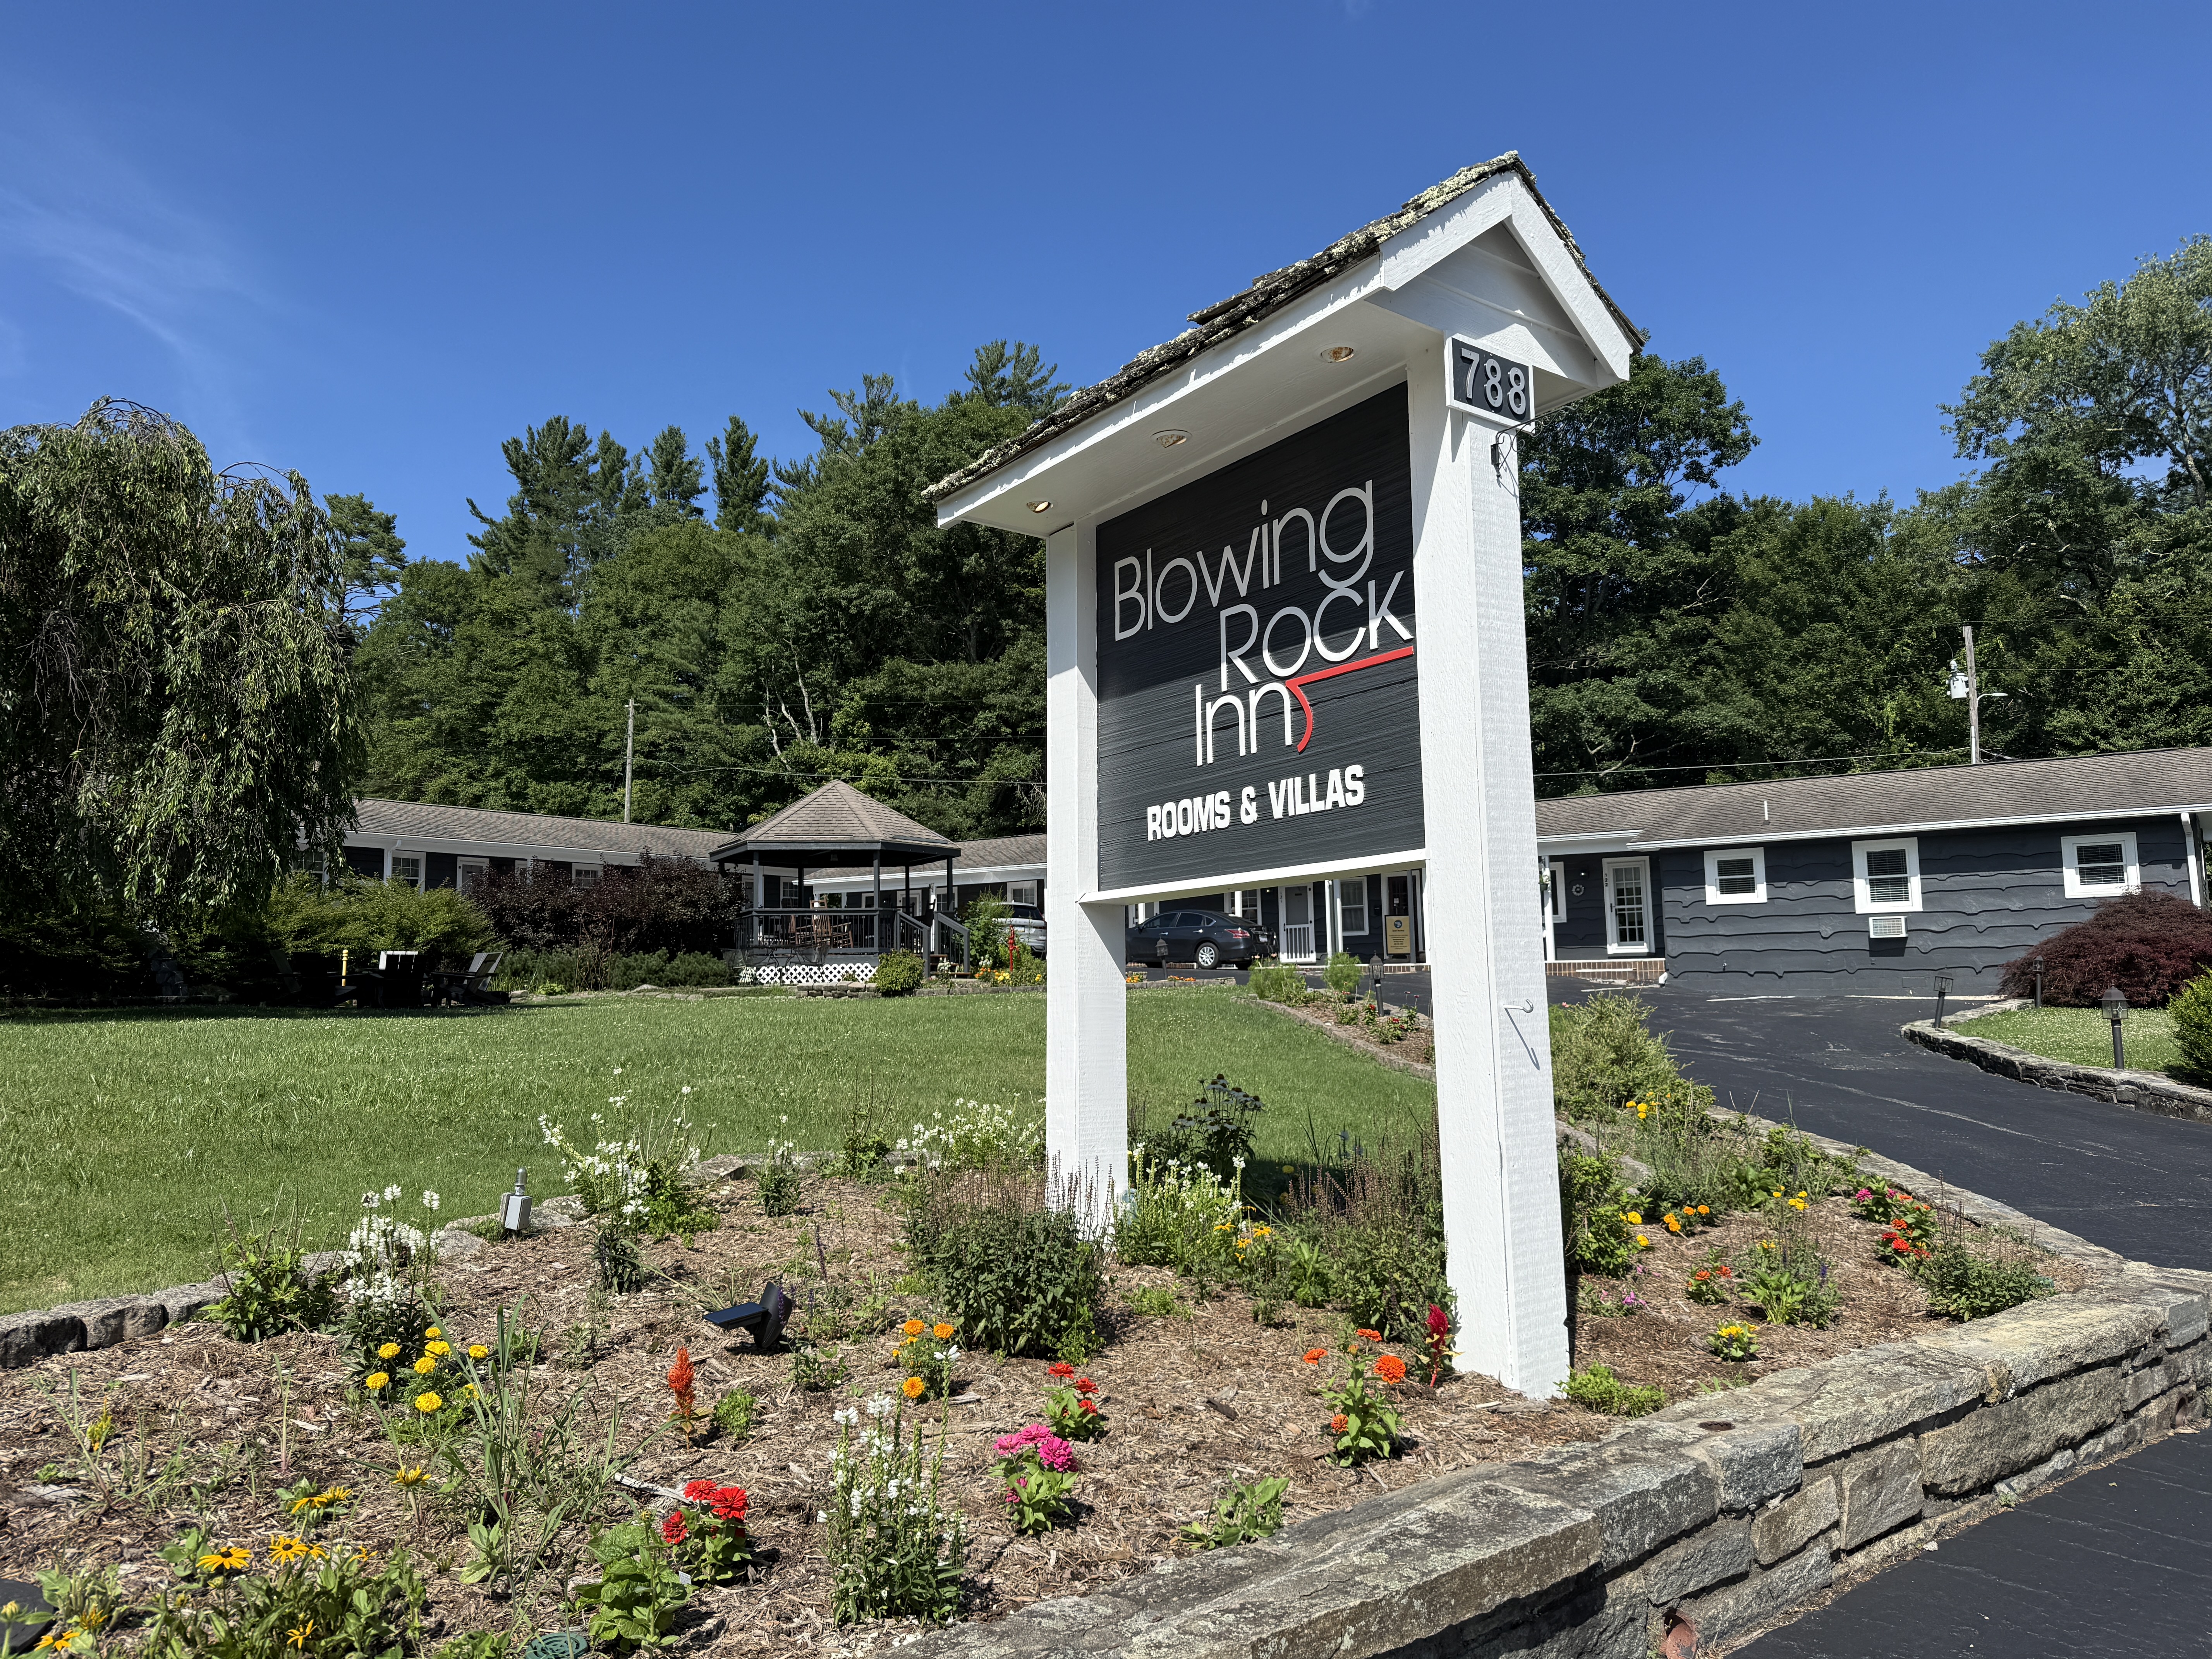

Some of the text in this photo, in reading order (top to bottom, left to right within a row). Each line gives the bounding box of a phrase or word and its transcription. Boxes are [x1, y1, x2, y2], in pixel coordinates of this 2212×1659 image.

[1461, 348, 1526, 415] 788
[1114, 480, 1373, 642] Blowing
[1195, 682, 1292, 767] Inn
[1147, 764, 1364, 842] ROOMS & VILLAS
